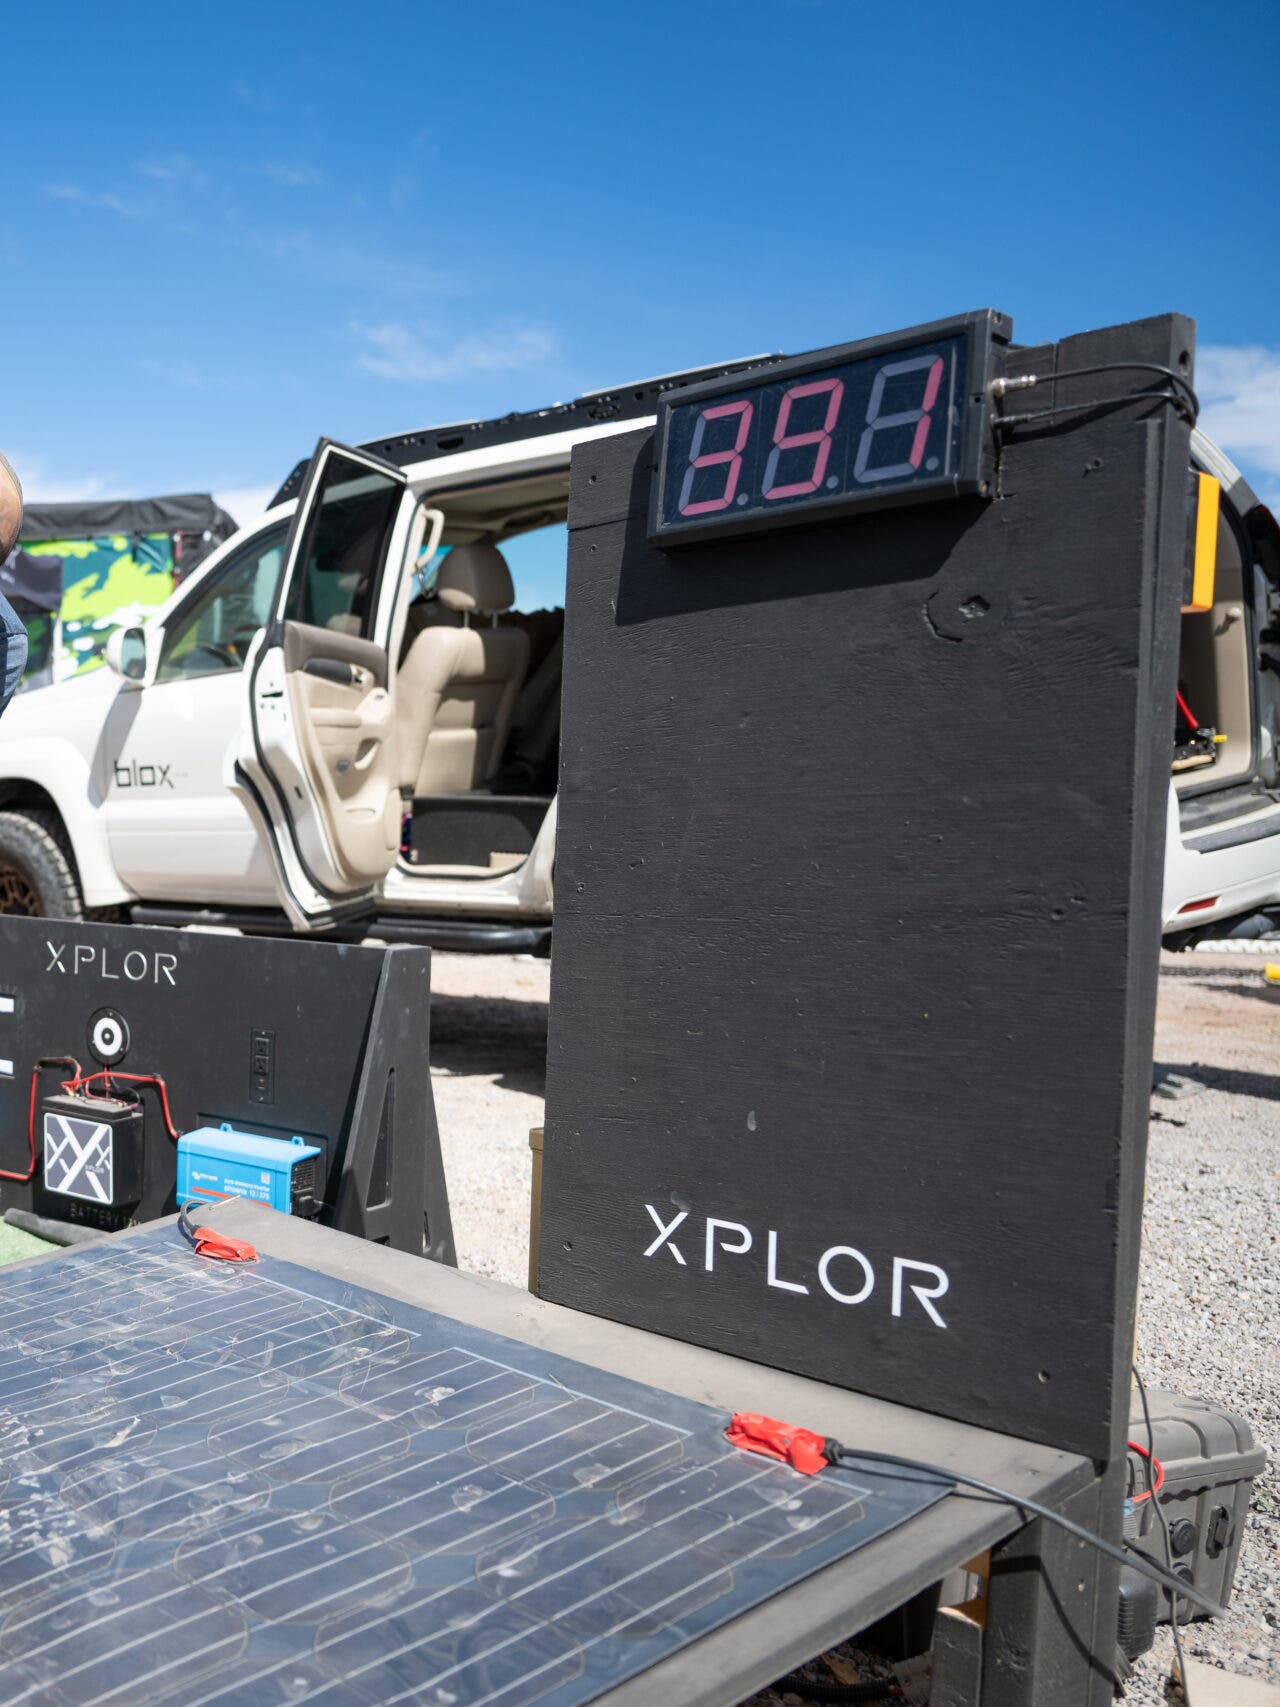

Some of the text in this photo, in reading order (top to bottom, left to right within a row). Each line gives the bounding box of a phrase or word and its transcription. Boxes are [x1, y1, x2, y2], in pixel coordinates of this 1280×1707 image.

[114, 759, 174, 789] blox
[46, 941, 177, 985] XPLOR
[643, 1204, 949, 1329] XPLOR
